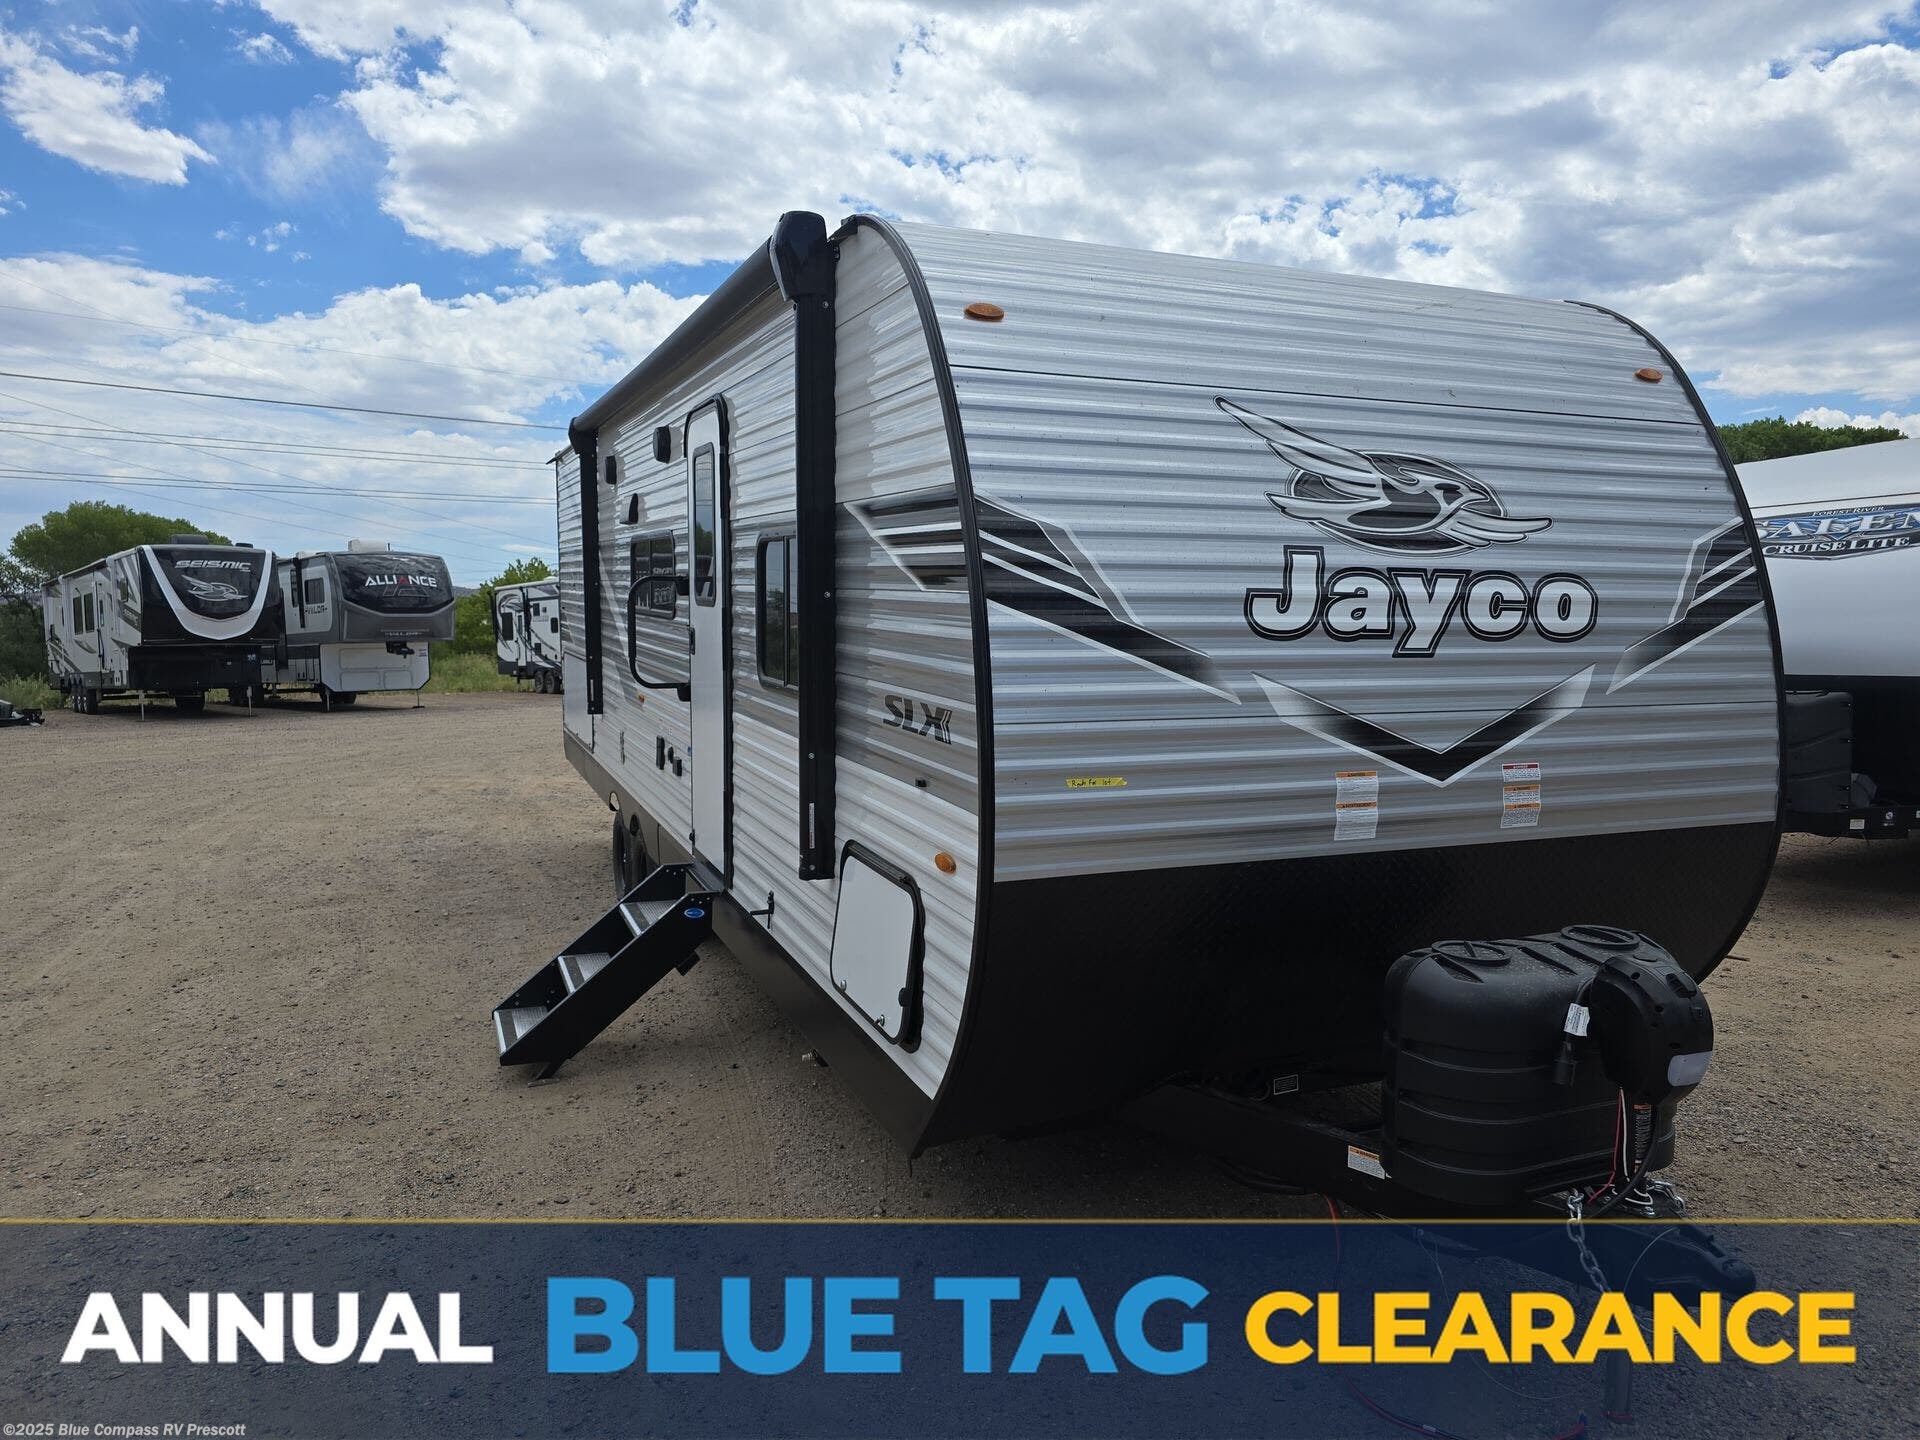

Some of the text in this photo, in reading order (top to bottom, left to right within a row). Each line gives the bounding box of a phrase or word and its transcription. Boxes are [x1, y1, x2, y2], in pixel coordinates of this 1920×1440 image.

[1812, 505, 1886, 517] FOREST RIVER
[1762, 537, 1911, 556] CRUISE LITE
[174, 560, 252, 573] SEISMIC
[364, 574, 438, 588] ALLIANCE
[1244, 545, 1599, 658] Jayco
